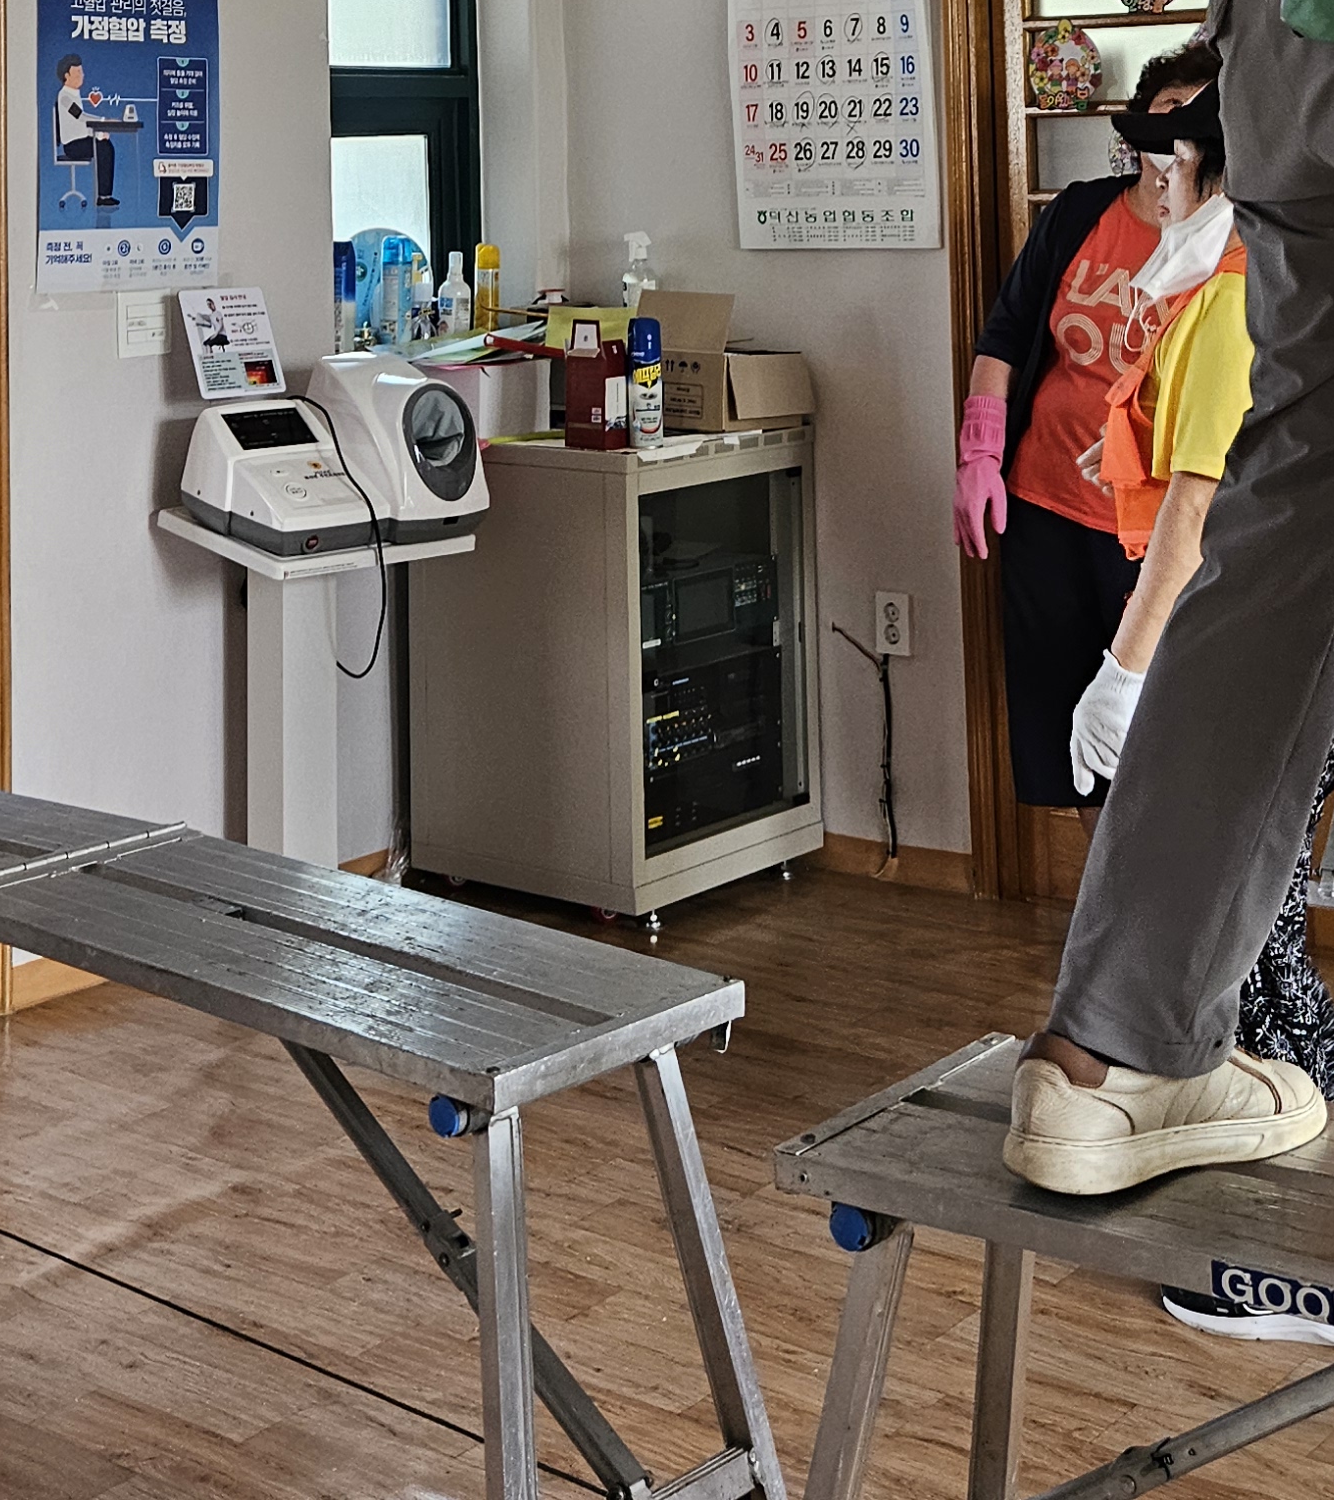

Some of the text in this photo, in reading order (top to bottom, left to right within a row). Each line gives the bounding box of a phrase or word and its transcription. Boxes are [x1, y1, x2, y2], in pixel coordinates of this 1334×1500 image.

[71, 15, 187, 44] 가정혈압 측정
[745, 14, 909, 41] 3 4 5 6 7 8 9
[743, 56, 915, 82] 10 11 12 13 14 15 16
[745, 97, 919, 122] 17 18 19 20 21 22 23
[745, 138, 919, 162] 24 31 25 26 27 28 29 30
